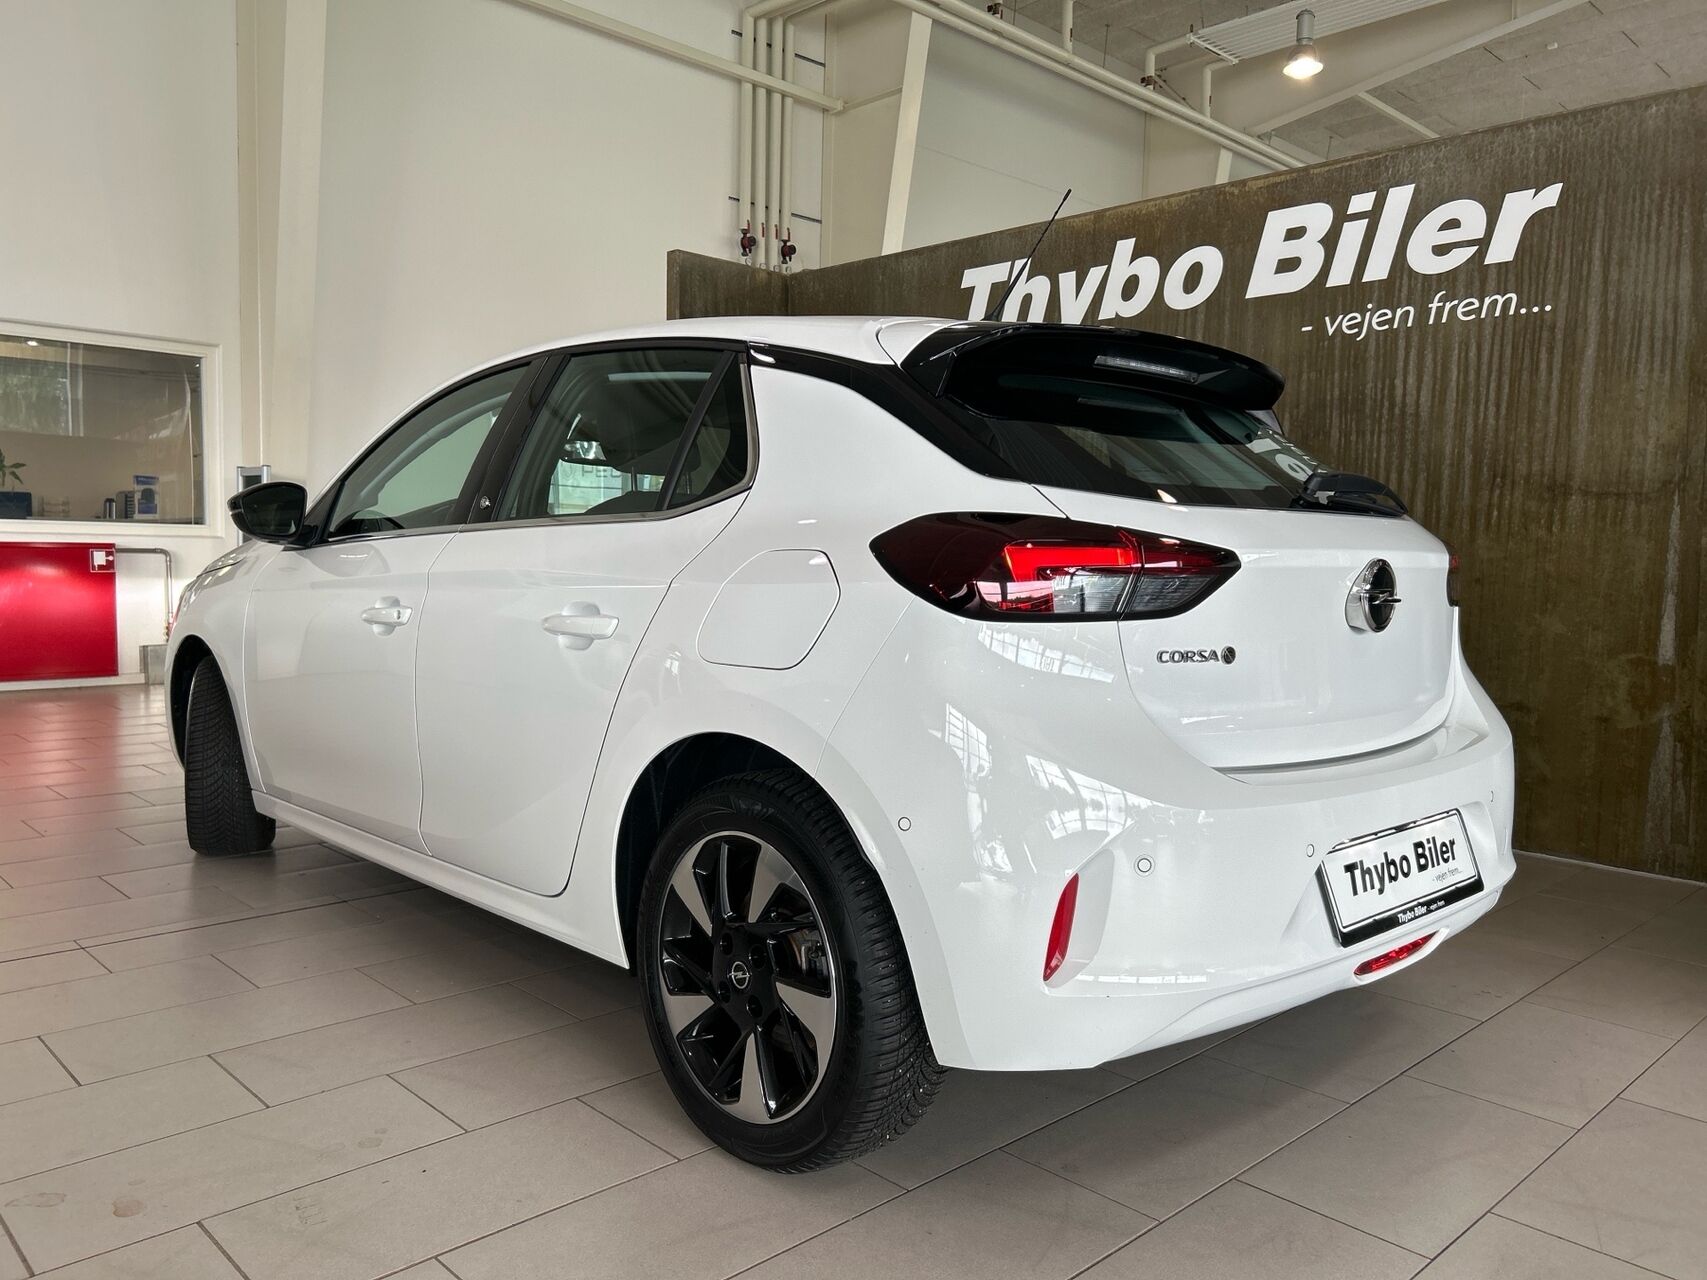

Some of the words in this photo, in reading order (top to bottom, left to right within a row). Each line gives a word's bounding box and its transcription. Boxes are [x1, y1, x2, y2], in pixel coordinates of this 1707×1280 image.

[961, 238, 1224, 324] Thybo
[1245, 182, 1564, 299] Biler
[1325, 303, 1415, 341] vejen
[1428, 290, 1552, 325] frem...
[1157, 649, 1220, 664] CORSA
[1343, 851, 1412, 897] Thybo
[1412, 836, 1457, 873] Biler
